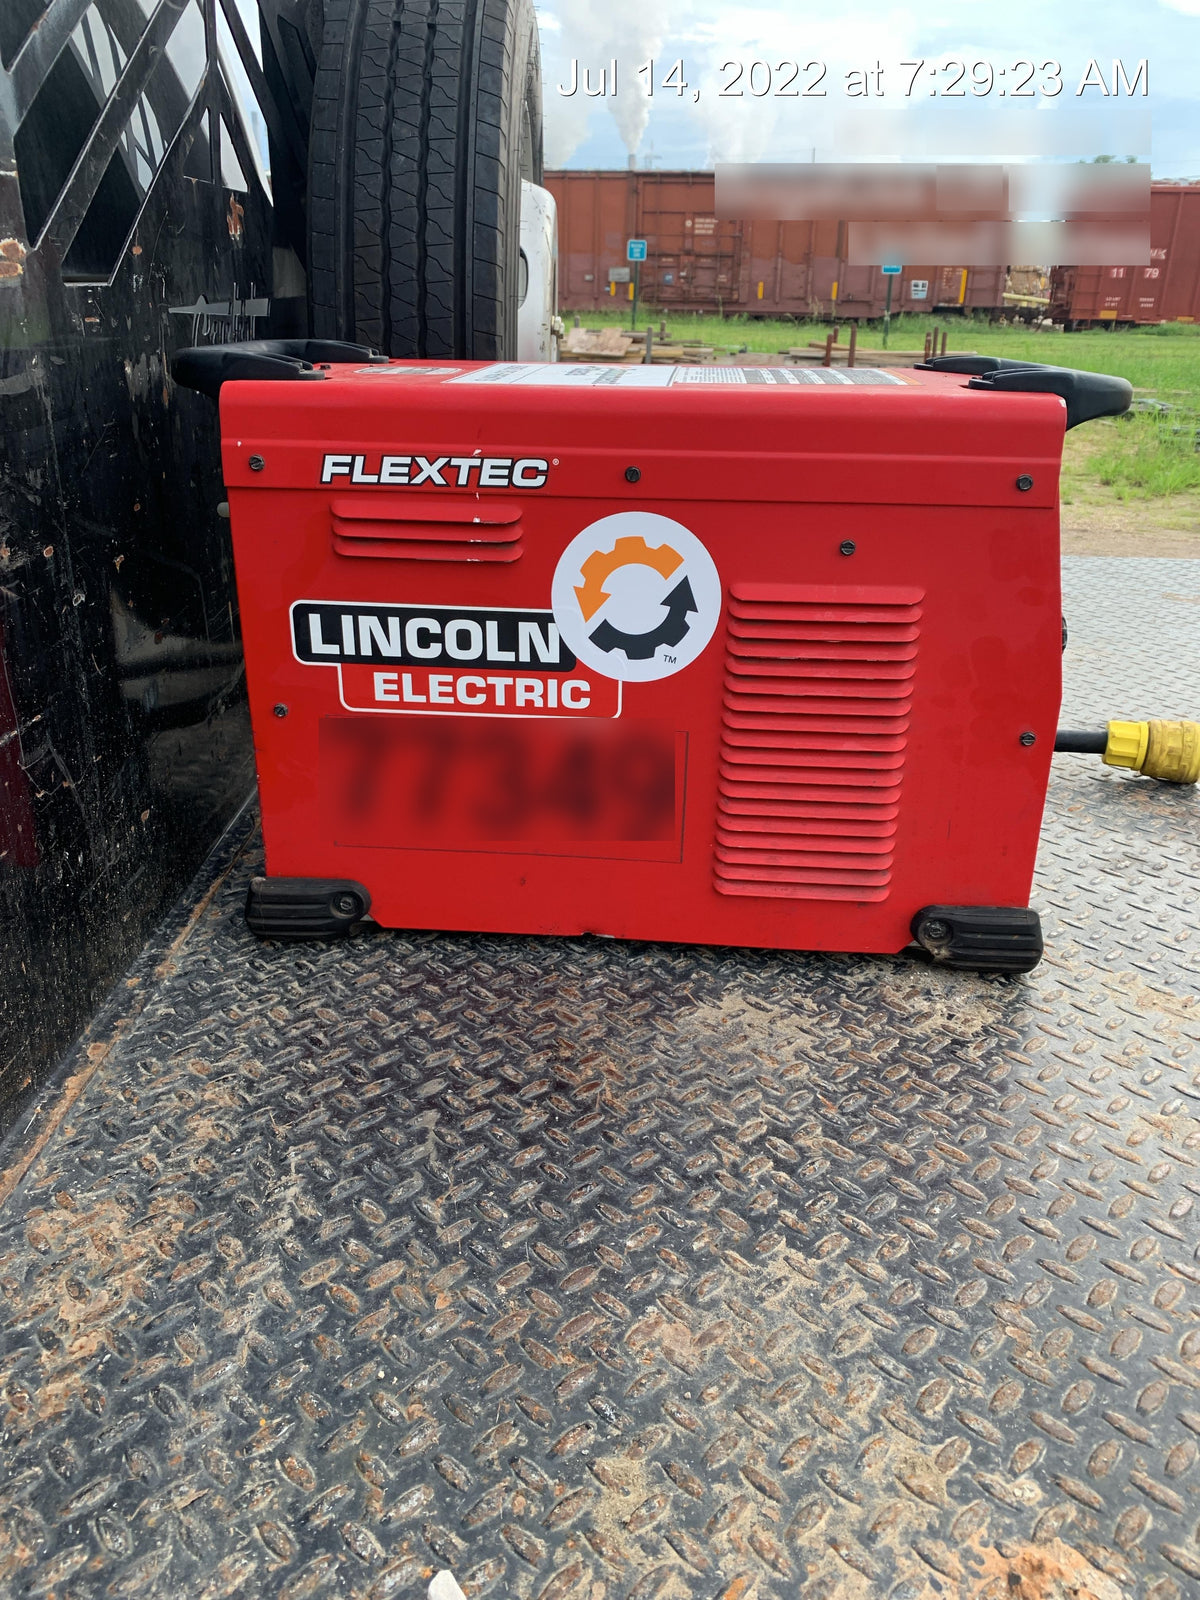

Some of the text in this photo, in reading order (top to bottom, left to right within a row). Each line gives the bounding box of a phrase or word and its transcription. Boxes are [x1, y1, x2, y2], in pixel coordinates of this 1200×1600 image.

[307, 612, 561, 664] LINCOLN
[663, 654, 677, 664] TM
[372, 671, 592, 710] ELECTRIC
